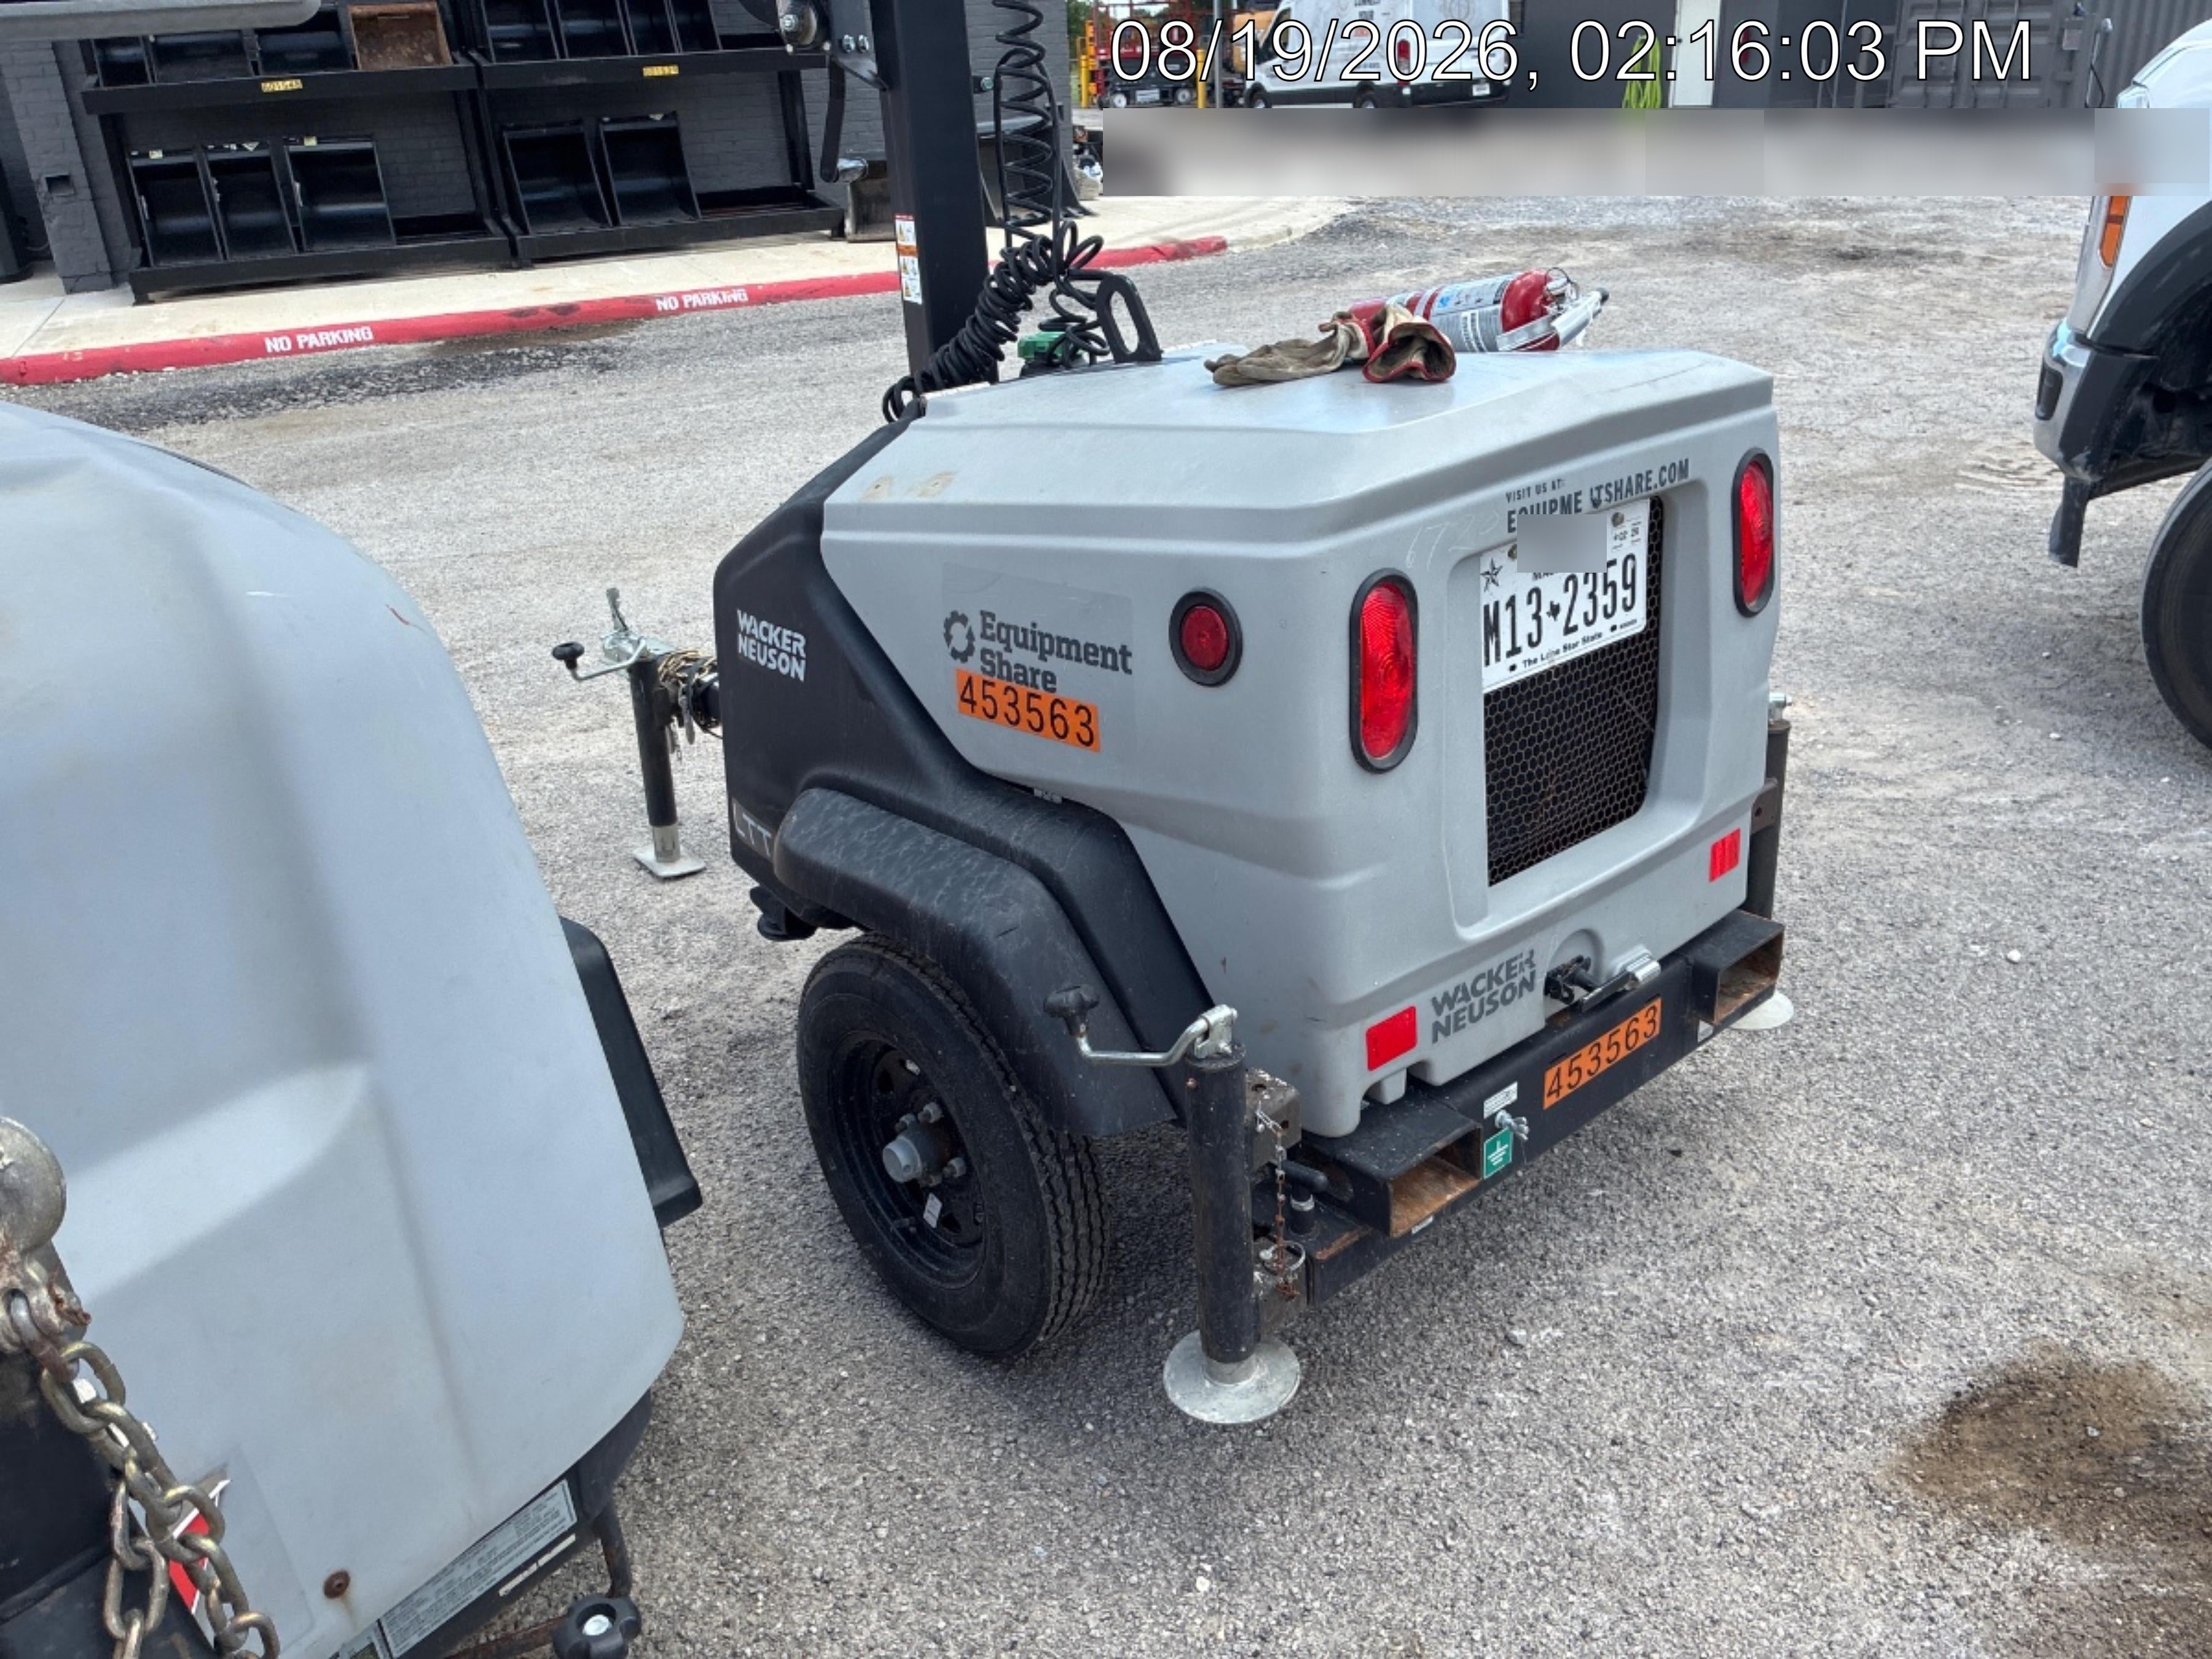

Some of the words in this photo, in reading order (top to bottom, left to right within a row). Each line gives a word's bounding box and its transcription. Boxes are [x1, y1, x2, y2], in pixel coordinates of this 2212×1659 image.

[656, 296, 679, 312] NO
[682, 289, 749, 308] PARKING
[265, 336, 292, 353] NO
[296, 326, 374, 349] PARKING
[1506, 486, 1531, 503] VISIT
[1535, 482, 1547, 495] US
[737, 608, 806, 658] WACKER
[738, 633, 806, 682] NEUSON
[980, 610, 1133, 675] Equipment
[1522, 657, 1538, 669] The
[1563, 641, 1580, 653] Star
[1582, 632, 1603, 643] State
[980, 647, 1057, 693] Share
[960, 674, 1095, 748] 453563
[1432, 949, 1536, 1017] WACKER
[1432, 969, 1536, 1044] NEUSON
[1547, 1005, 1657, 1099] 453563
